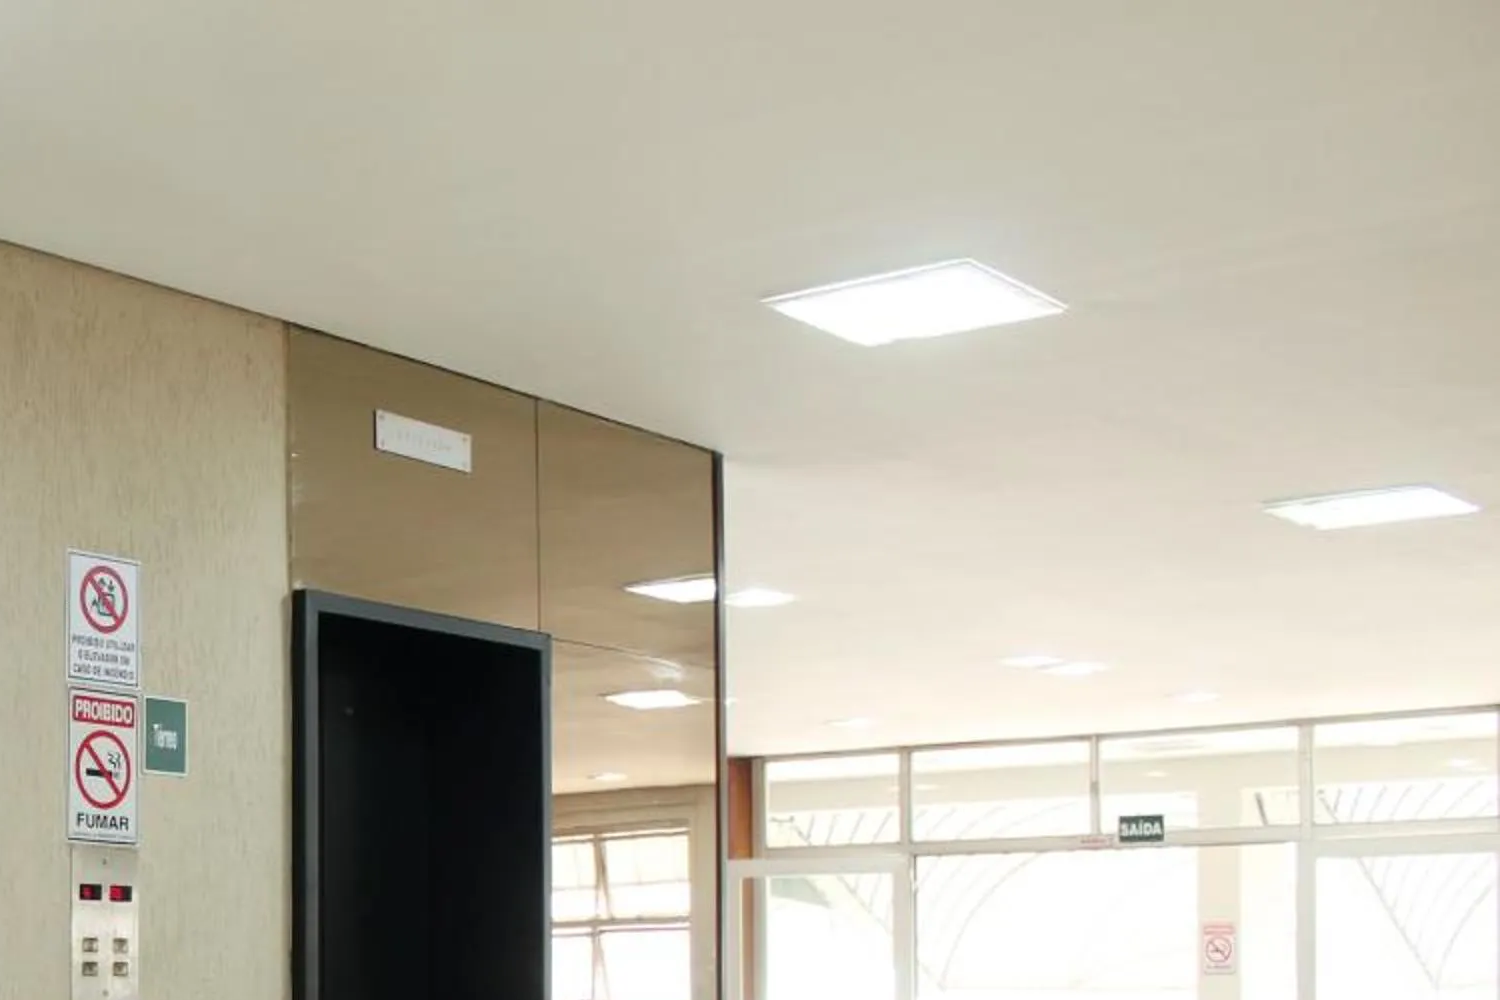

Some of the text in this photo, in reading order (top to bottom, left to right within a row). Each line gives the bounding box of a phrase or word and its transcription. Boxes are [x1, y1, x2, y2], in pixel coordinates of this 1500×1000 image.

[75, 699, 133, 724] PROIBIDO
[77, 812, 129, 831] FUMAR
[1121, 820, 1162, 837] SAÍDA
